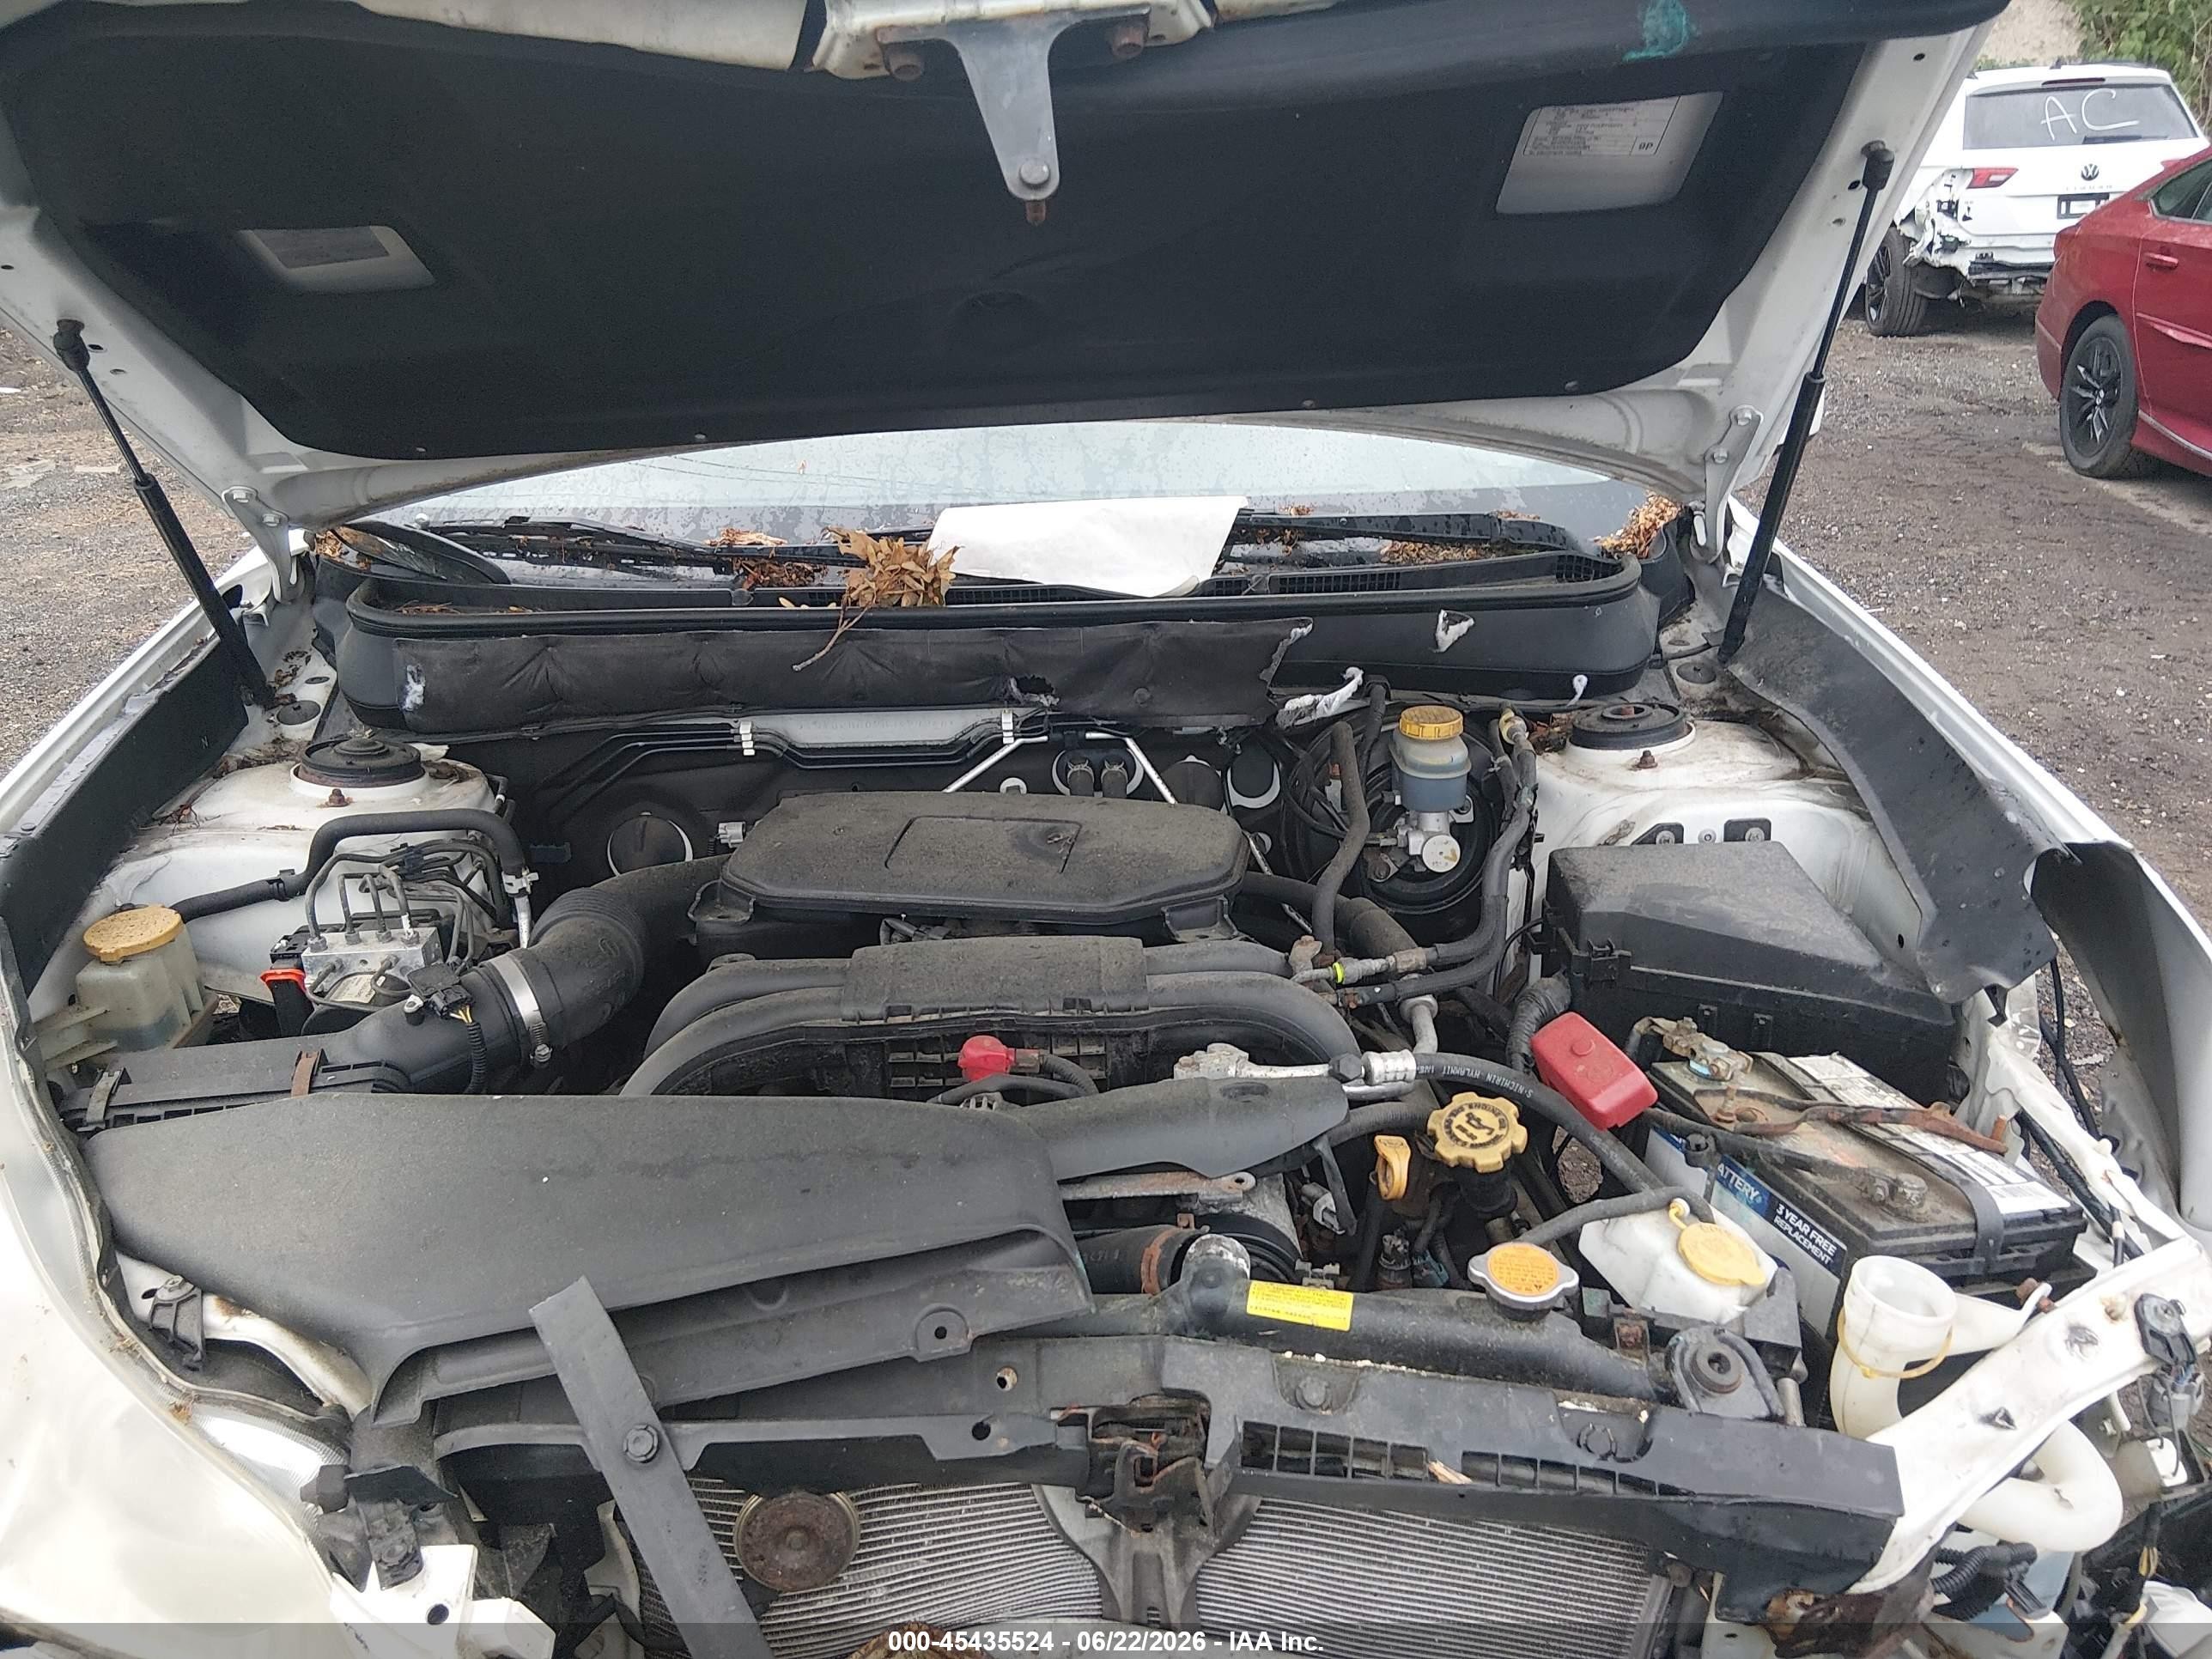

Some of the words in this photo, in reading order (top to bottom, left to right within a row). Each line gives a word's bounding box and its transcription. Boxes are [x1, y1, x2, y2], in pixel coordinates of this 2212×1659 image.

[1717, 1162, 1760, 1201] ATTERY
[1773, 1215, 1833, 1265] REPLACEMENT
[1776, 1203, 1785, 1216] 3
[1784, 1209, 1810, 1237] YEAR
[1809, 1229, 1838, 1257] FREE
